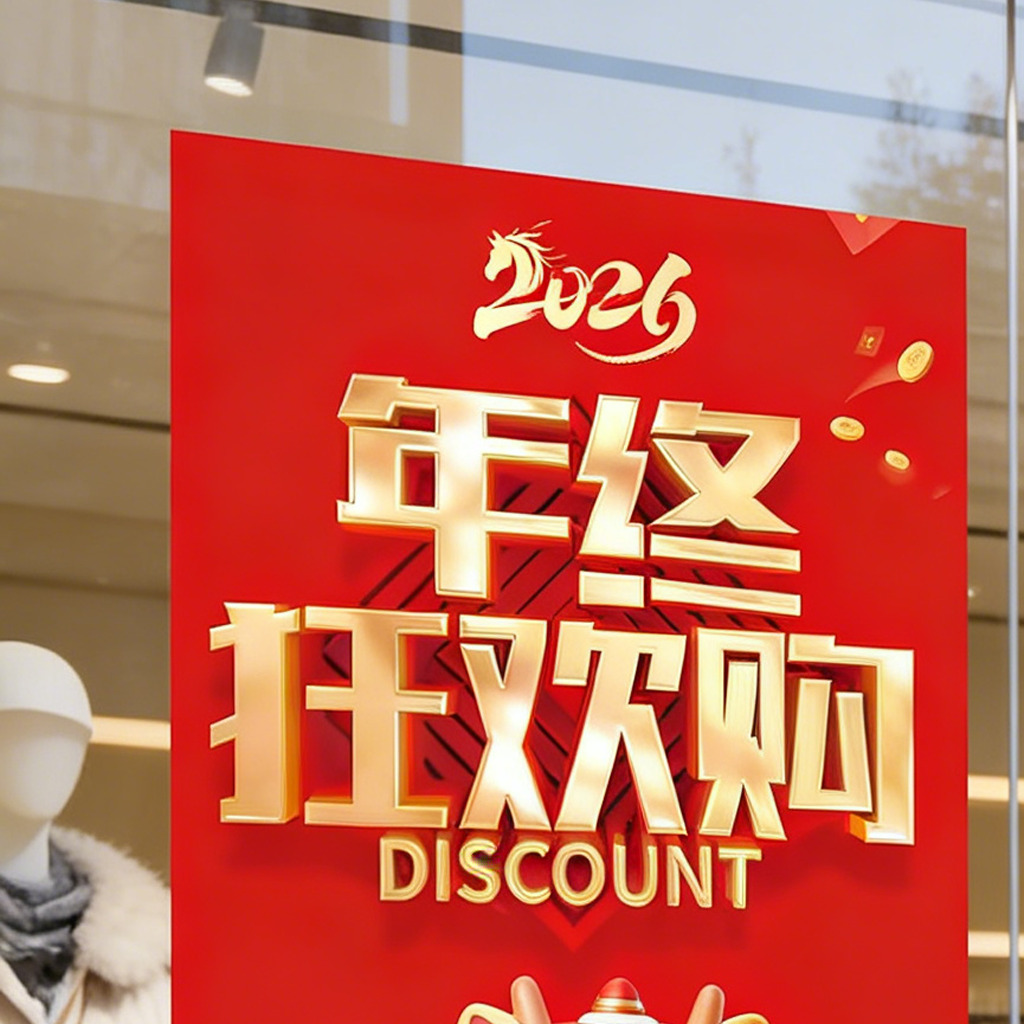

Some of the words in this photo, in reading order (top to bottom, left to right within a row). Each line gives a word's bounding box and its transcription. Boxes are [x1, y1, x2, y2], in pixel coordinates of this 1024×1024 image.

[473, 219, 697, 366] 2026
[337, 373, 800, 617] 年终
[209, 602, 915, 846] 狂欢购
[378, 833, 763, 910] DISCOUNT
